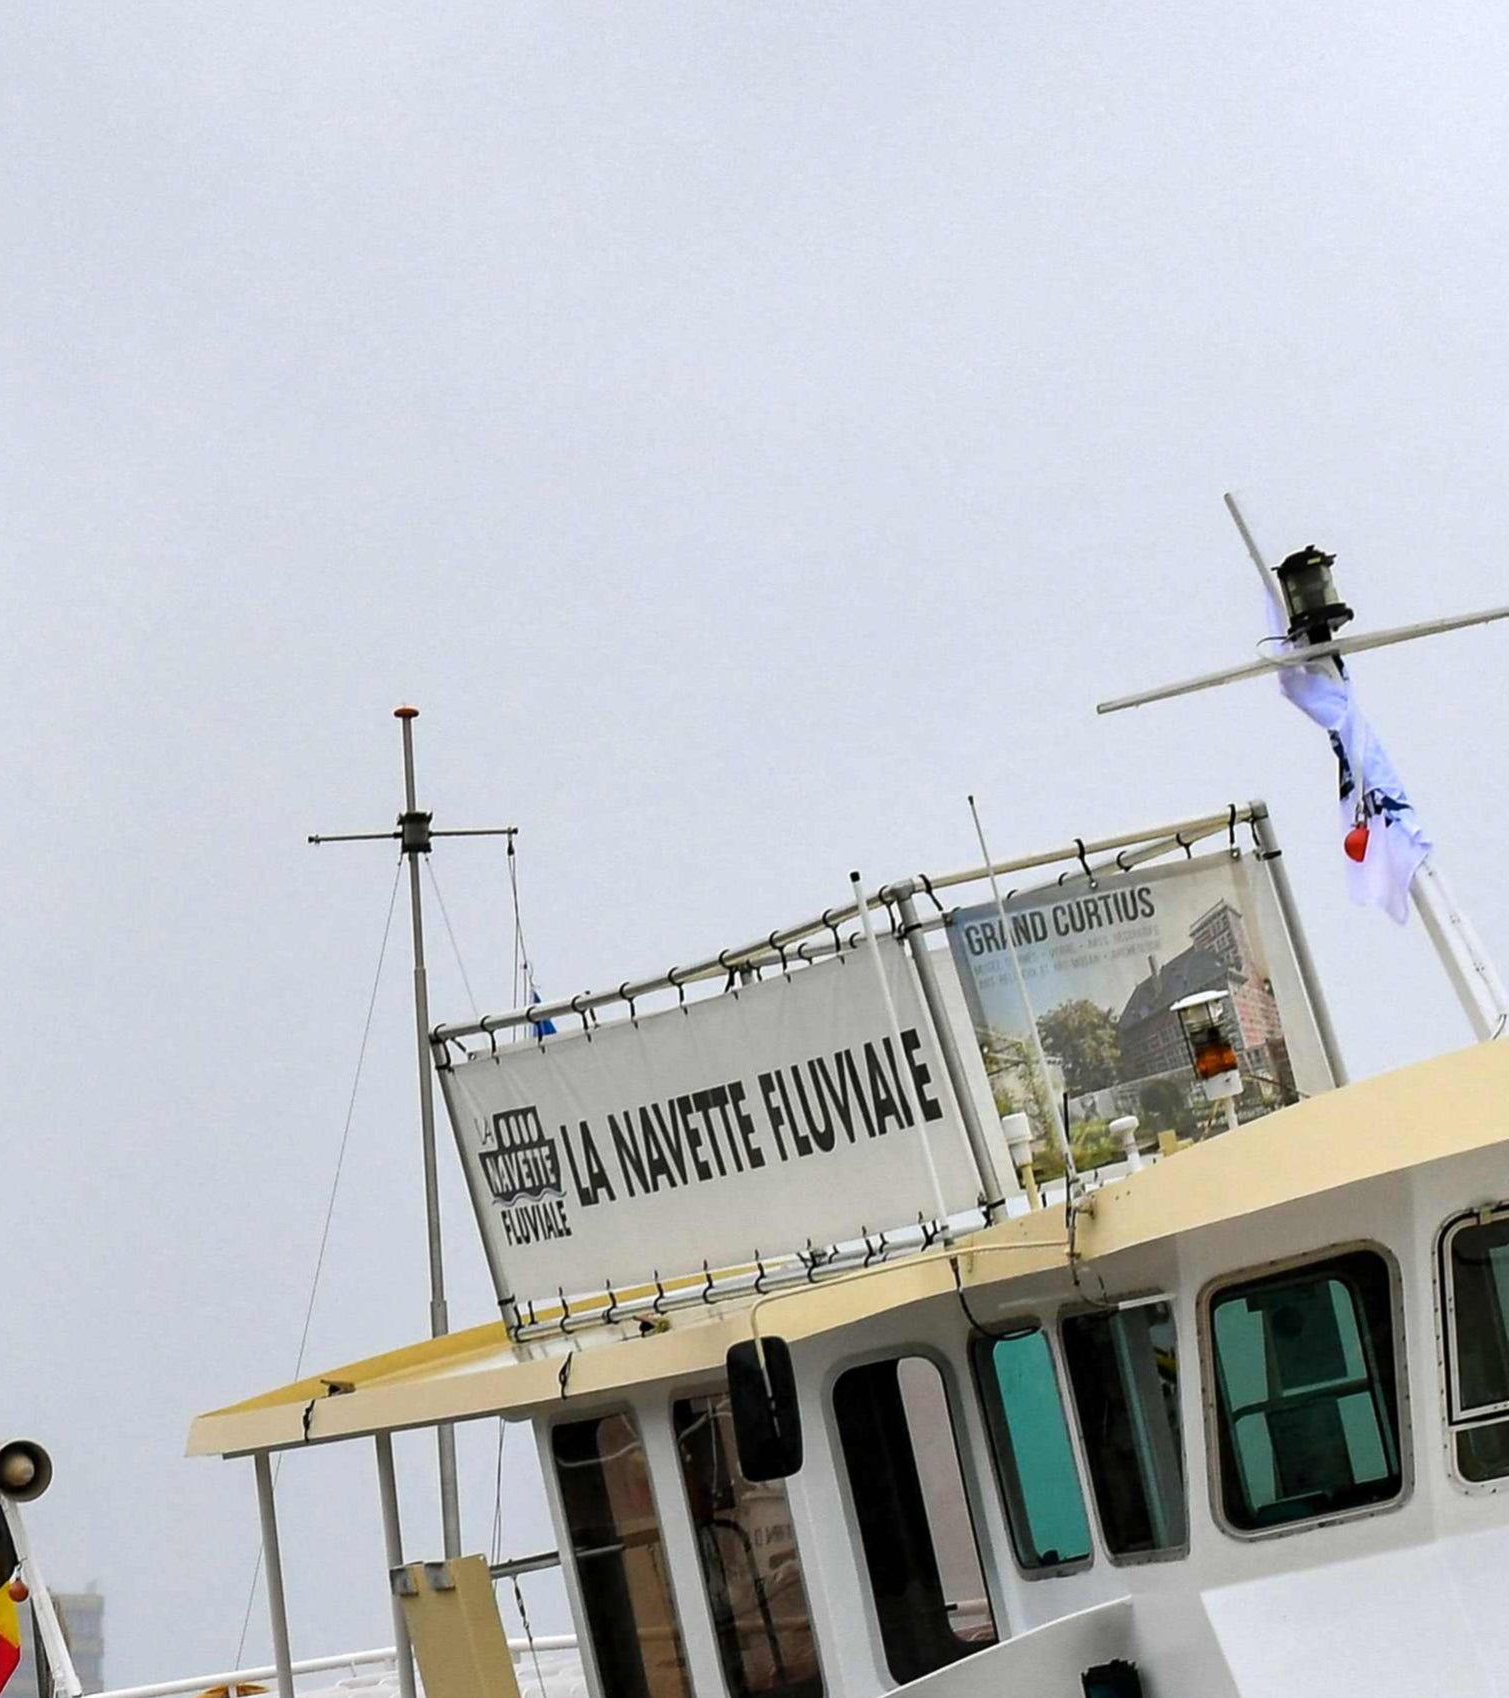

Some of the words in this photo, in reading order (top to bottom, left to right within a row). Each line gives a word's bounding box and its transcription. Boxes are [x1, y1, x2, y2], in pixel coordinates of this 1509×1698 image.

[965, 910, 1048, 956] GRAND
[1052, 886, 1155, 937] CURTIUS
[559, 1121, 616, 1207] LA
[607, 1080, 766, 1198] NAVETTE
[757, 1028, 943, 1162] FLUVIALE
[485, 1146, 557, 1195] NAVETTE
[501, 1200, 573, 1246] FLUVIALE
